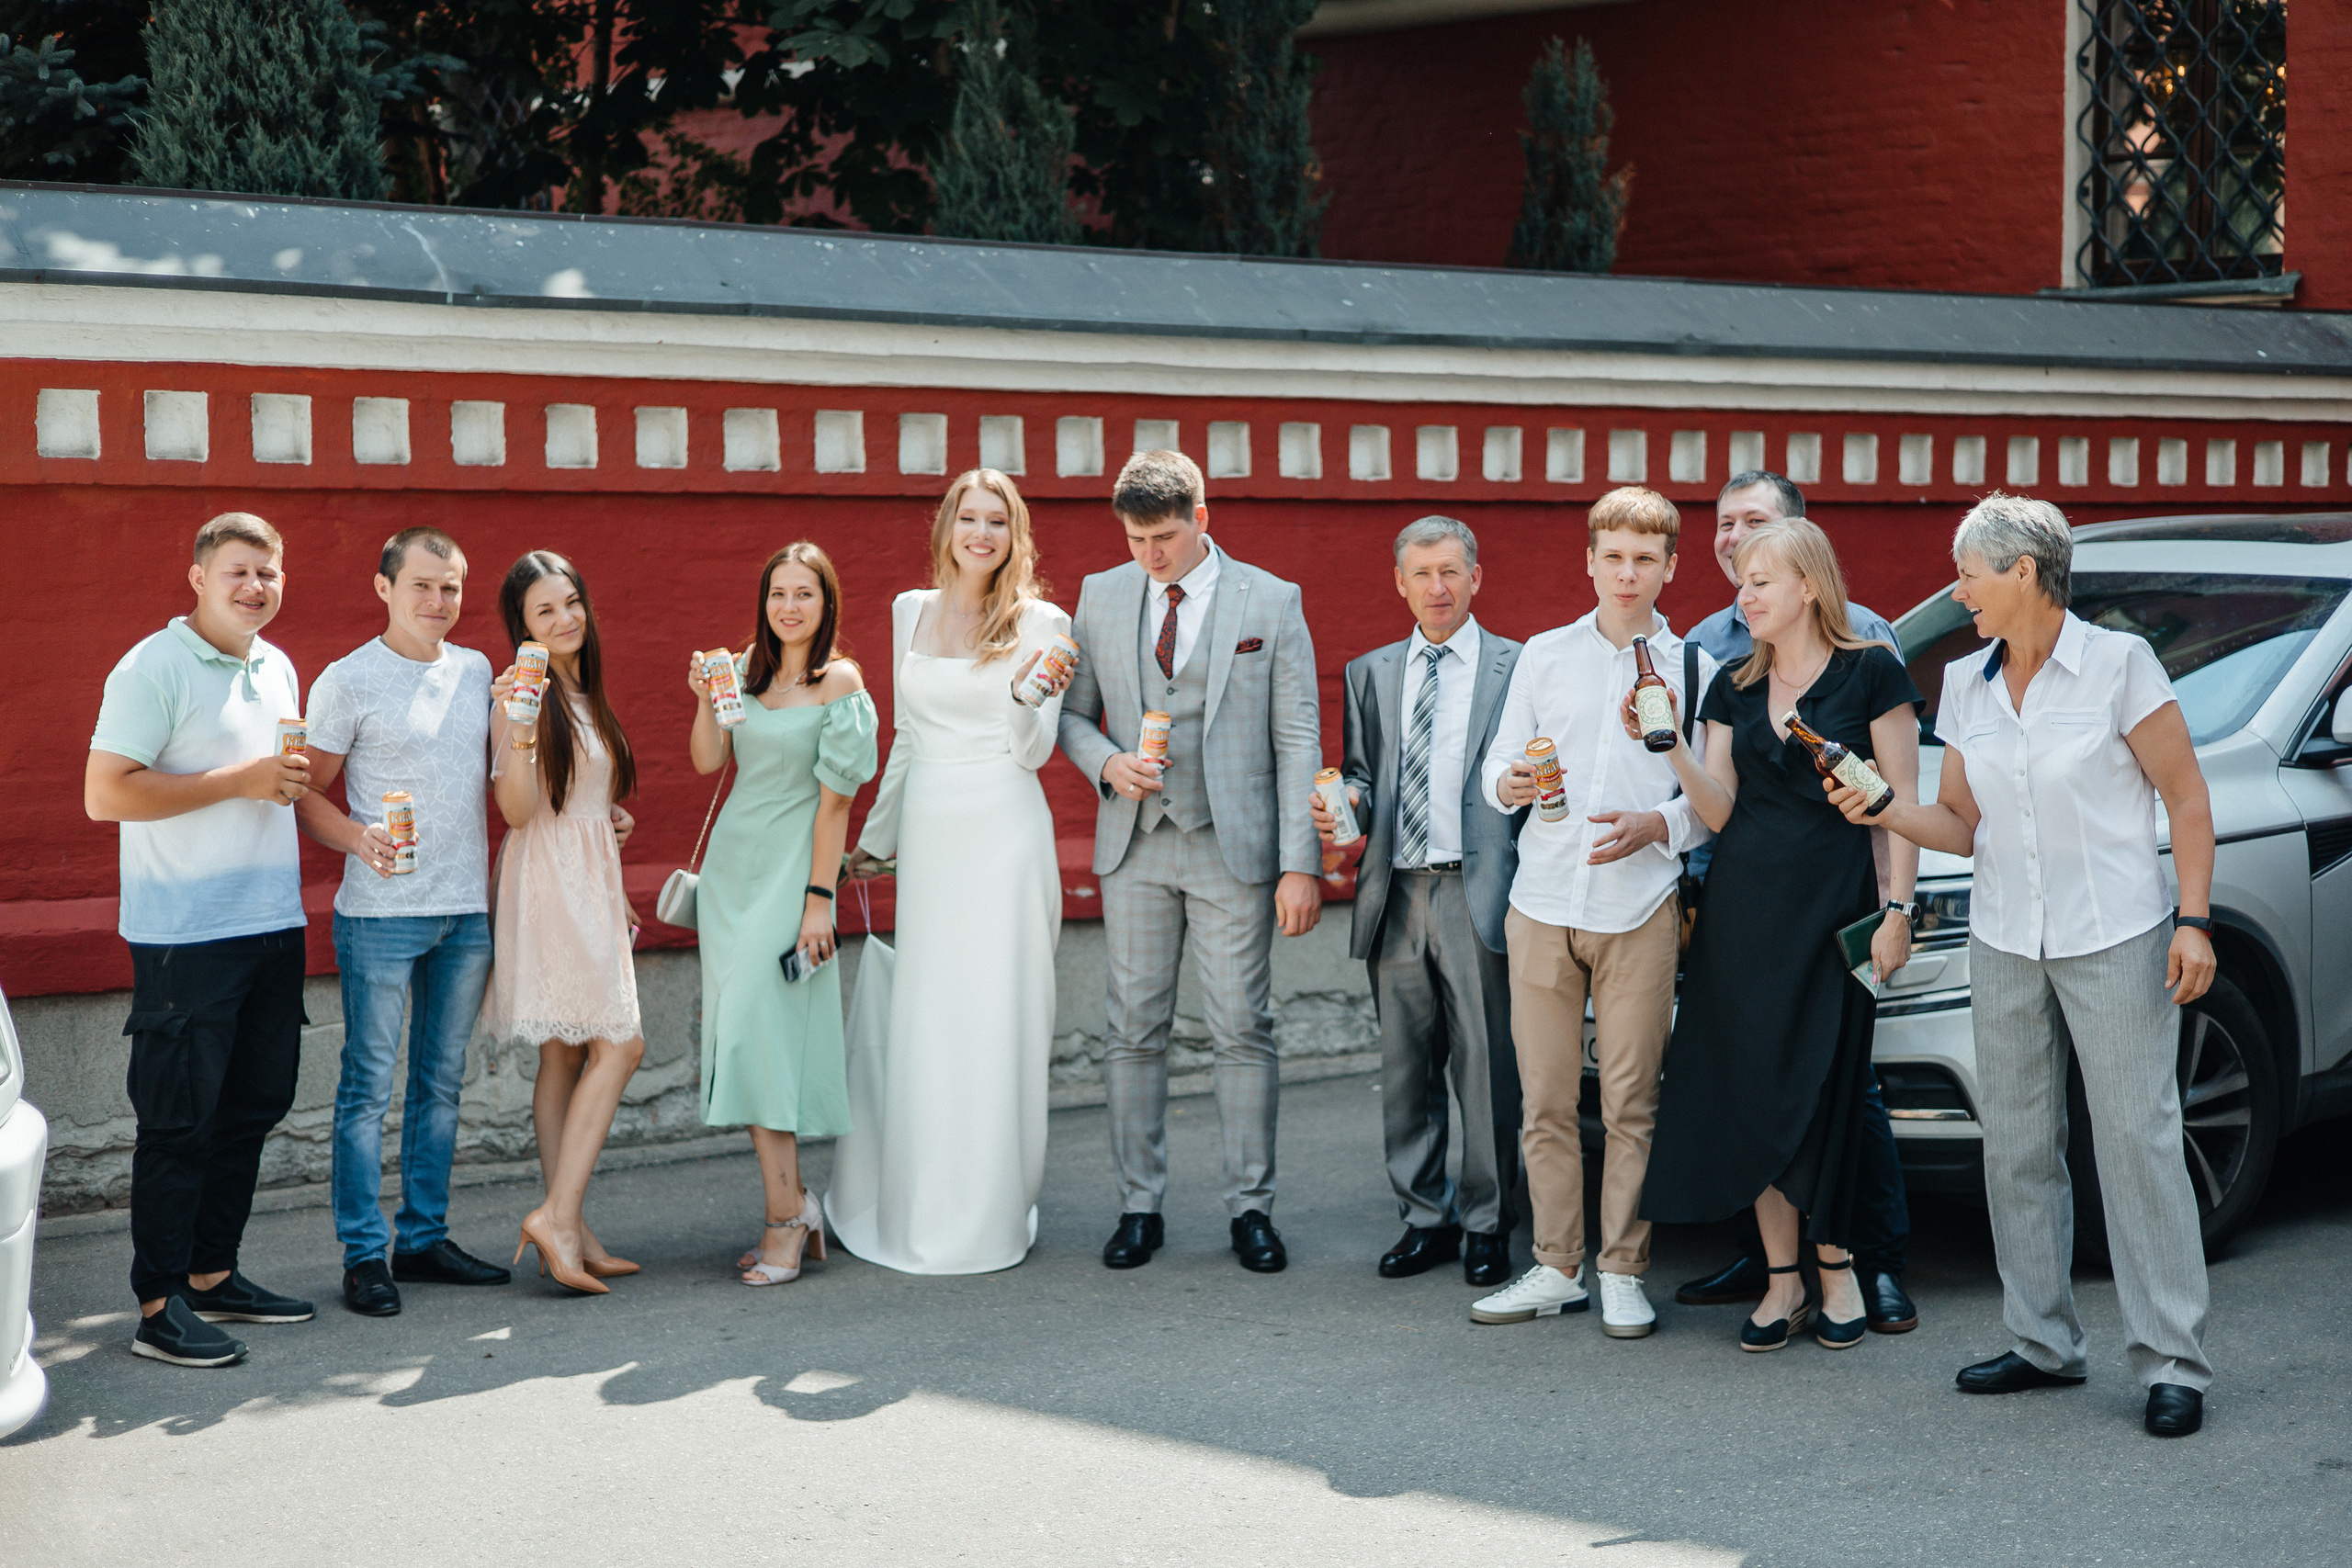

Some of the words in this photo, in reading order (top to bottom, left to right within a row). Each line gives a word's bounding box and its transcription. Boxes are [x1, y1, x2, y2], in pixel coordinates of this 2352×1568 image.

[1051, 649, 1069, 666] КВА
[518, 658, 545, 671] КВАС
[710, 666, 730, 677] ВАС
[286, 736, 306, 747] КВА
